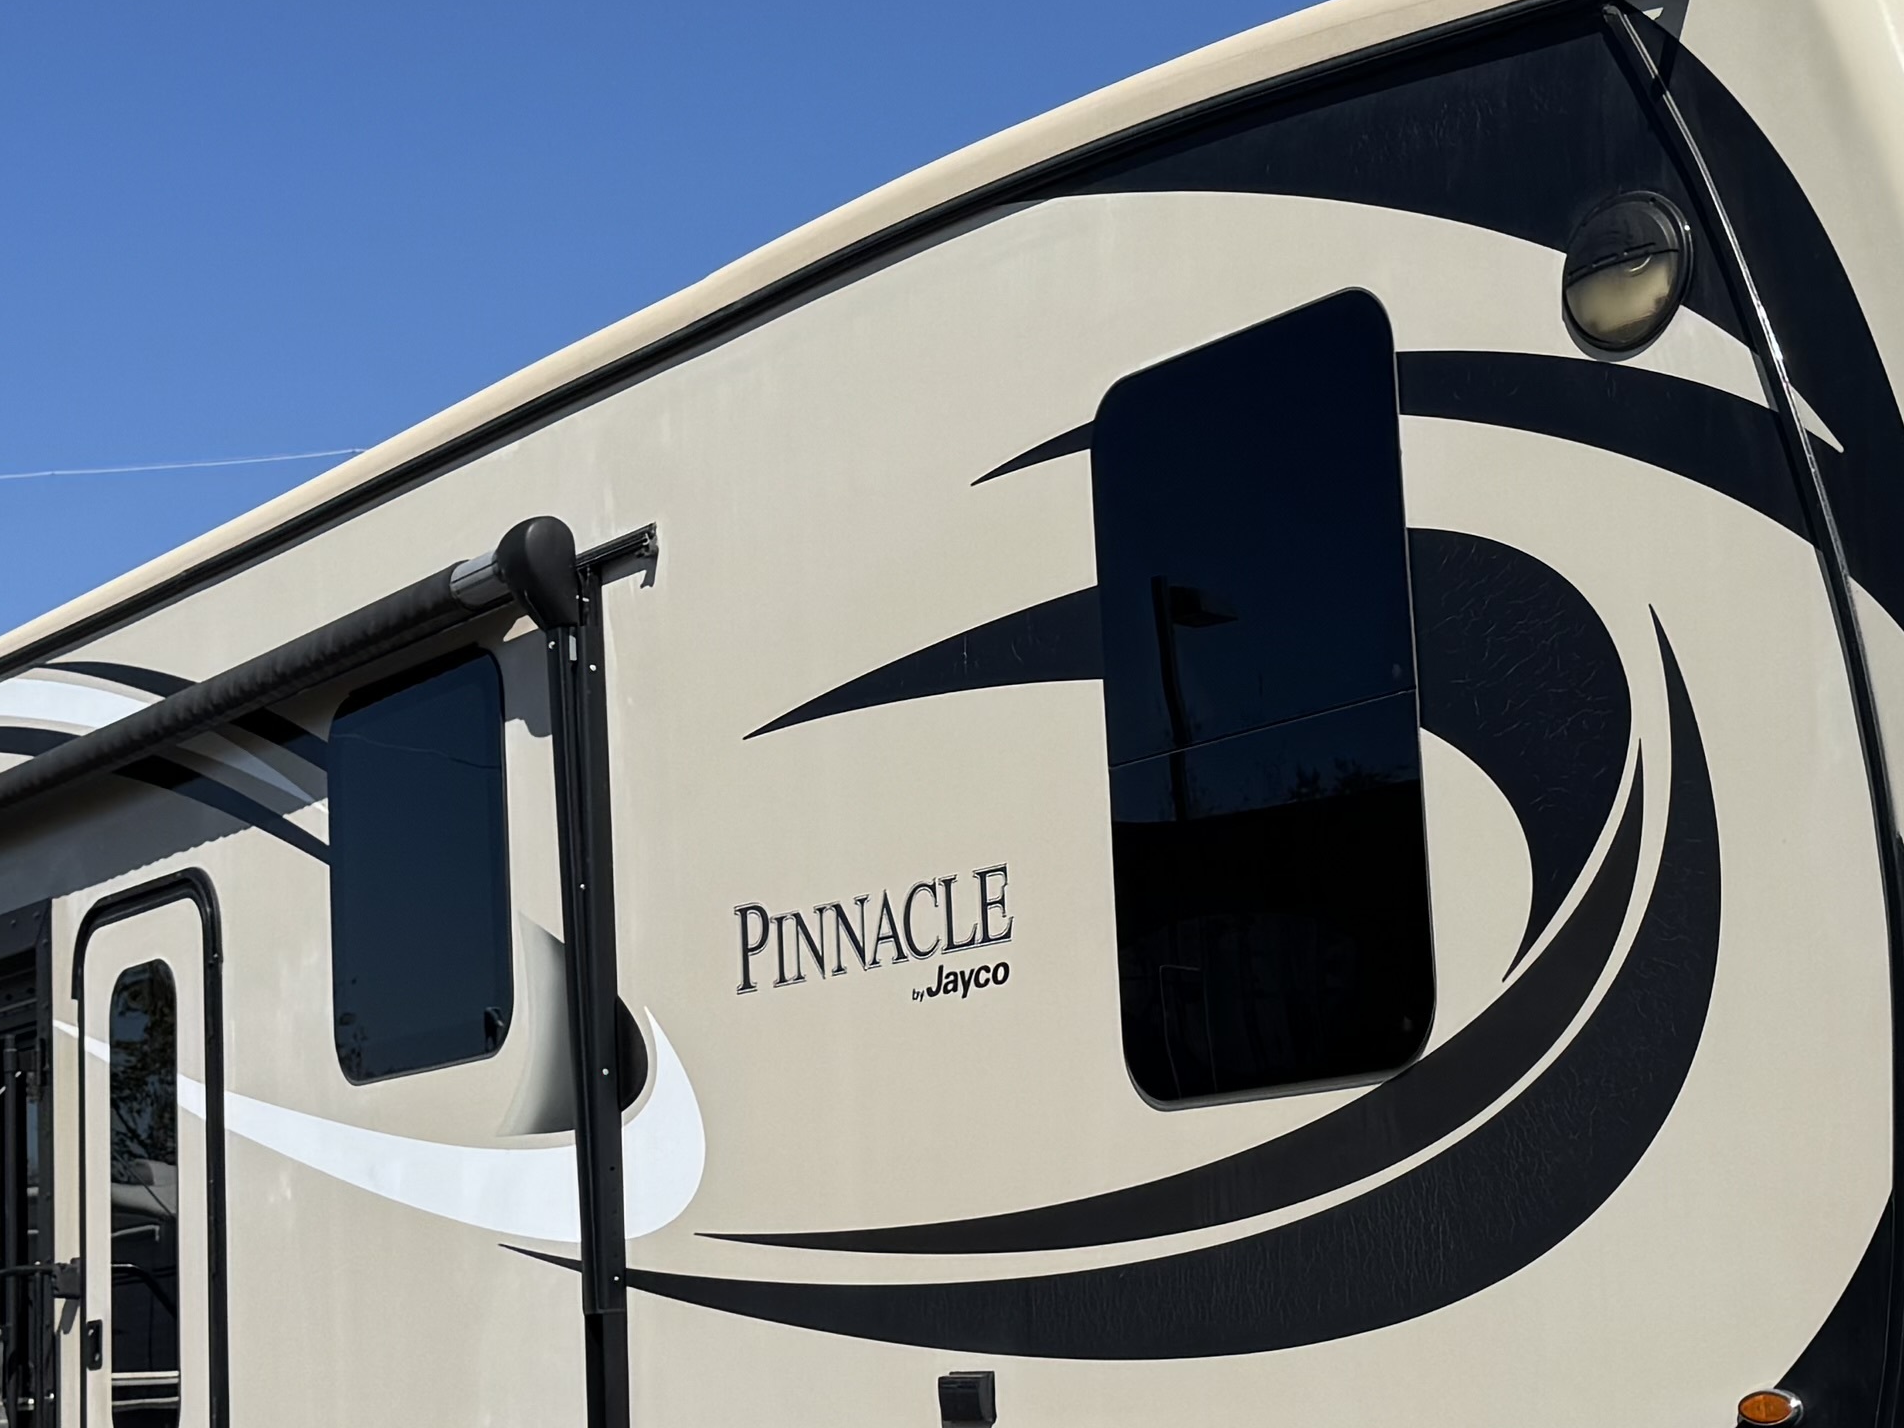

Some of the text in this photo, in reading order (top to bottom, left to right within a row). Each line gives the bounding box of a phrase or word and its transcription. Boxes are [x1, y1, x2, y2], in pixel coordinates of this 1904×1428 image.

[733, 862, 1014, 995] PINNACLE
[912, 961, 1010, 1003] by Jayco
